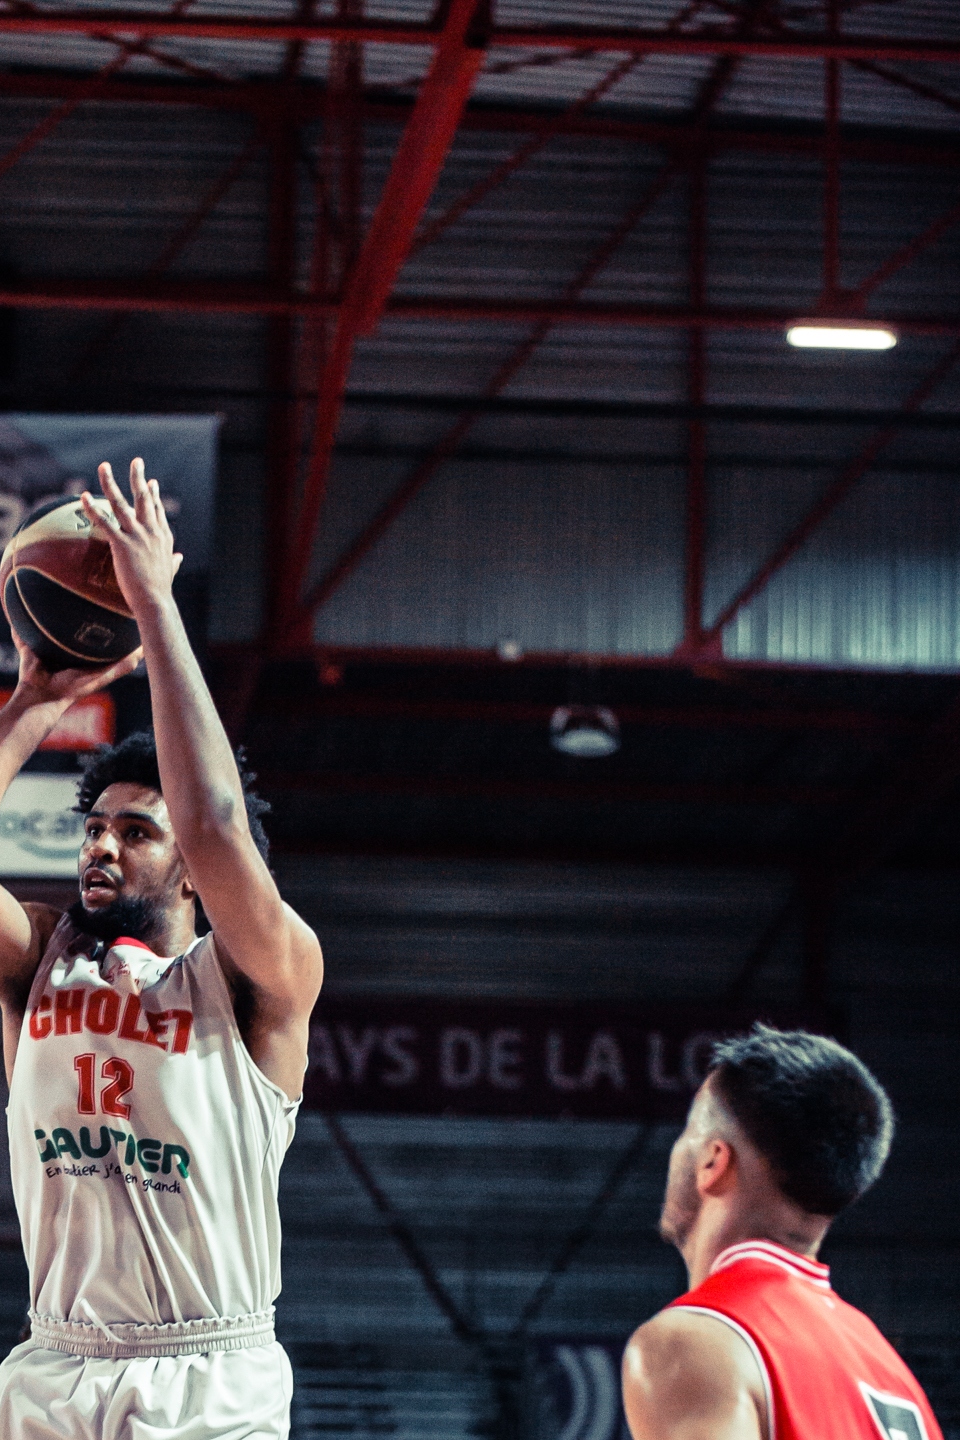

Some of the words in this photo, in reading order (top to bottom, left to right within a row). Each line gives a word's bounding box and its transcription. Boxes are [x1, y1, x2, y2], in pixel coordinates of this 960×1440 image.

[29, 988, 194, 1055] CHOLET
[74, 1053, 134, 1120] 12
[307, 1024, 421, 1088] AYS
[439, 1026, 523, 1090] DE
[547, 1031, 626, 1092] LA
[34, 1125, 190, 1179] GAUTIER
